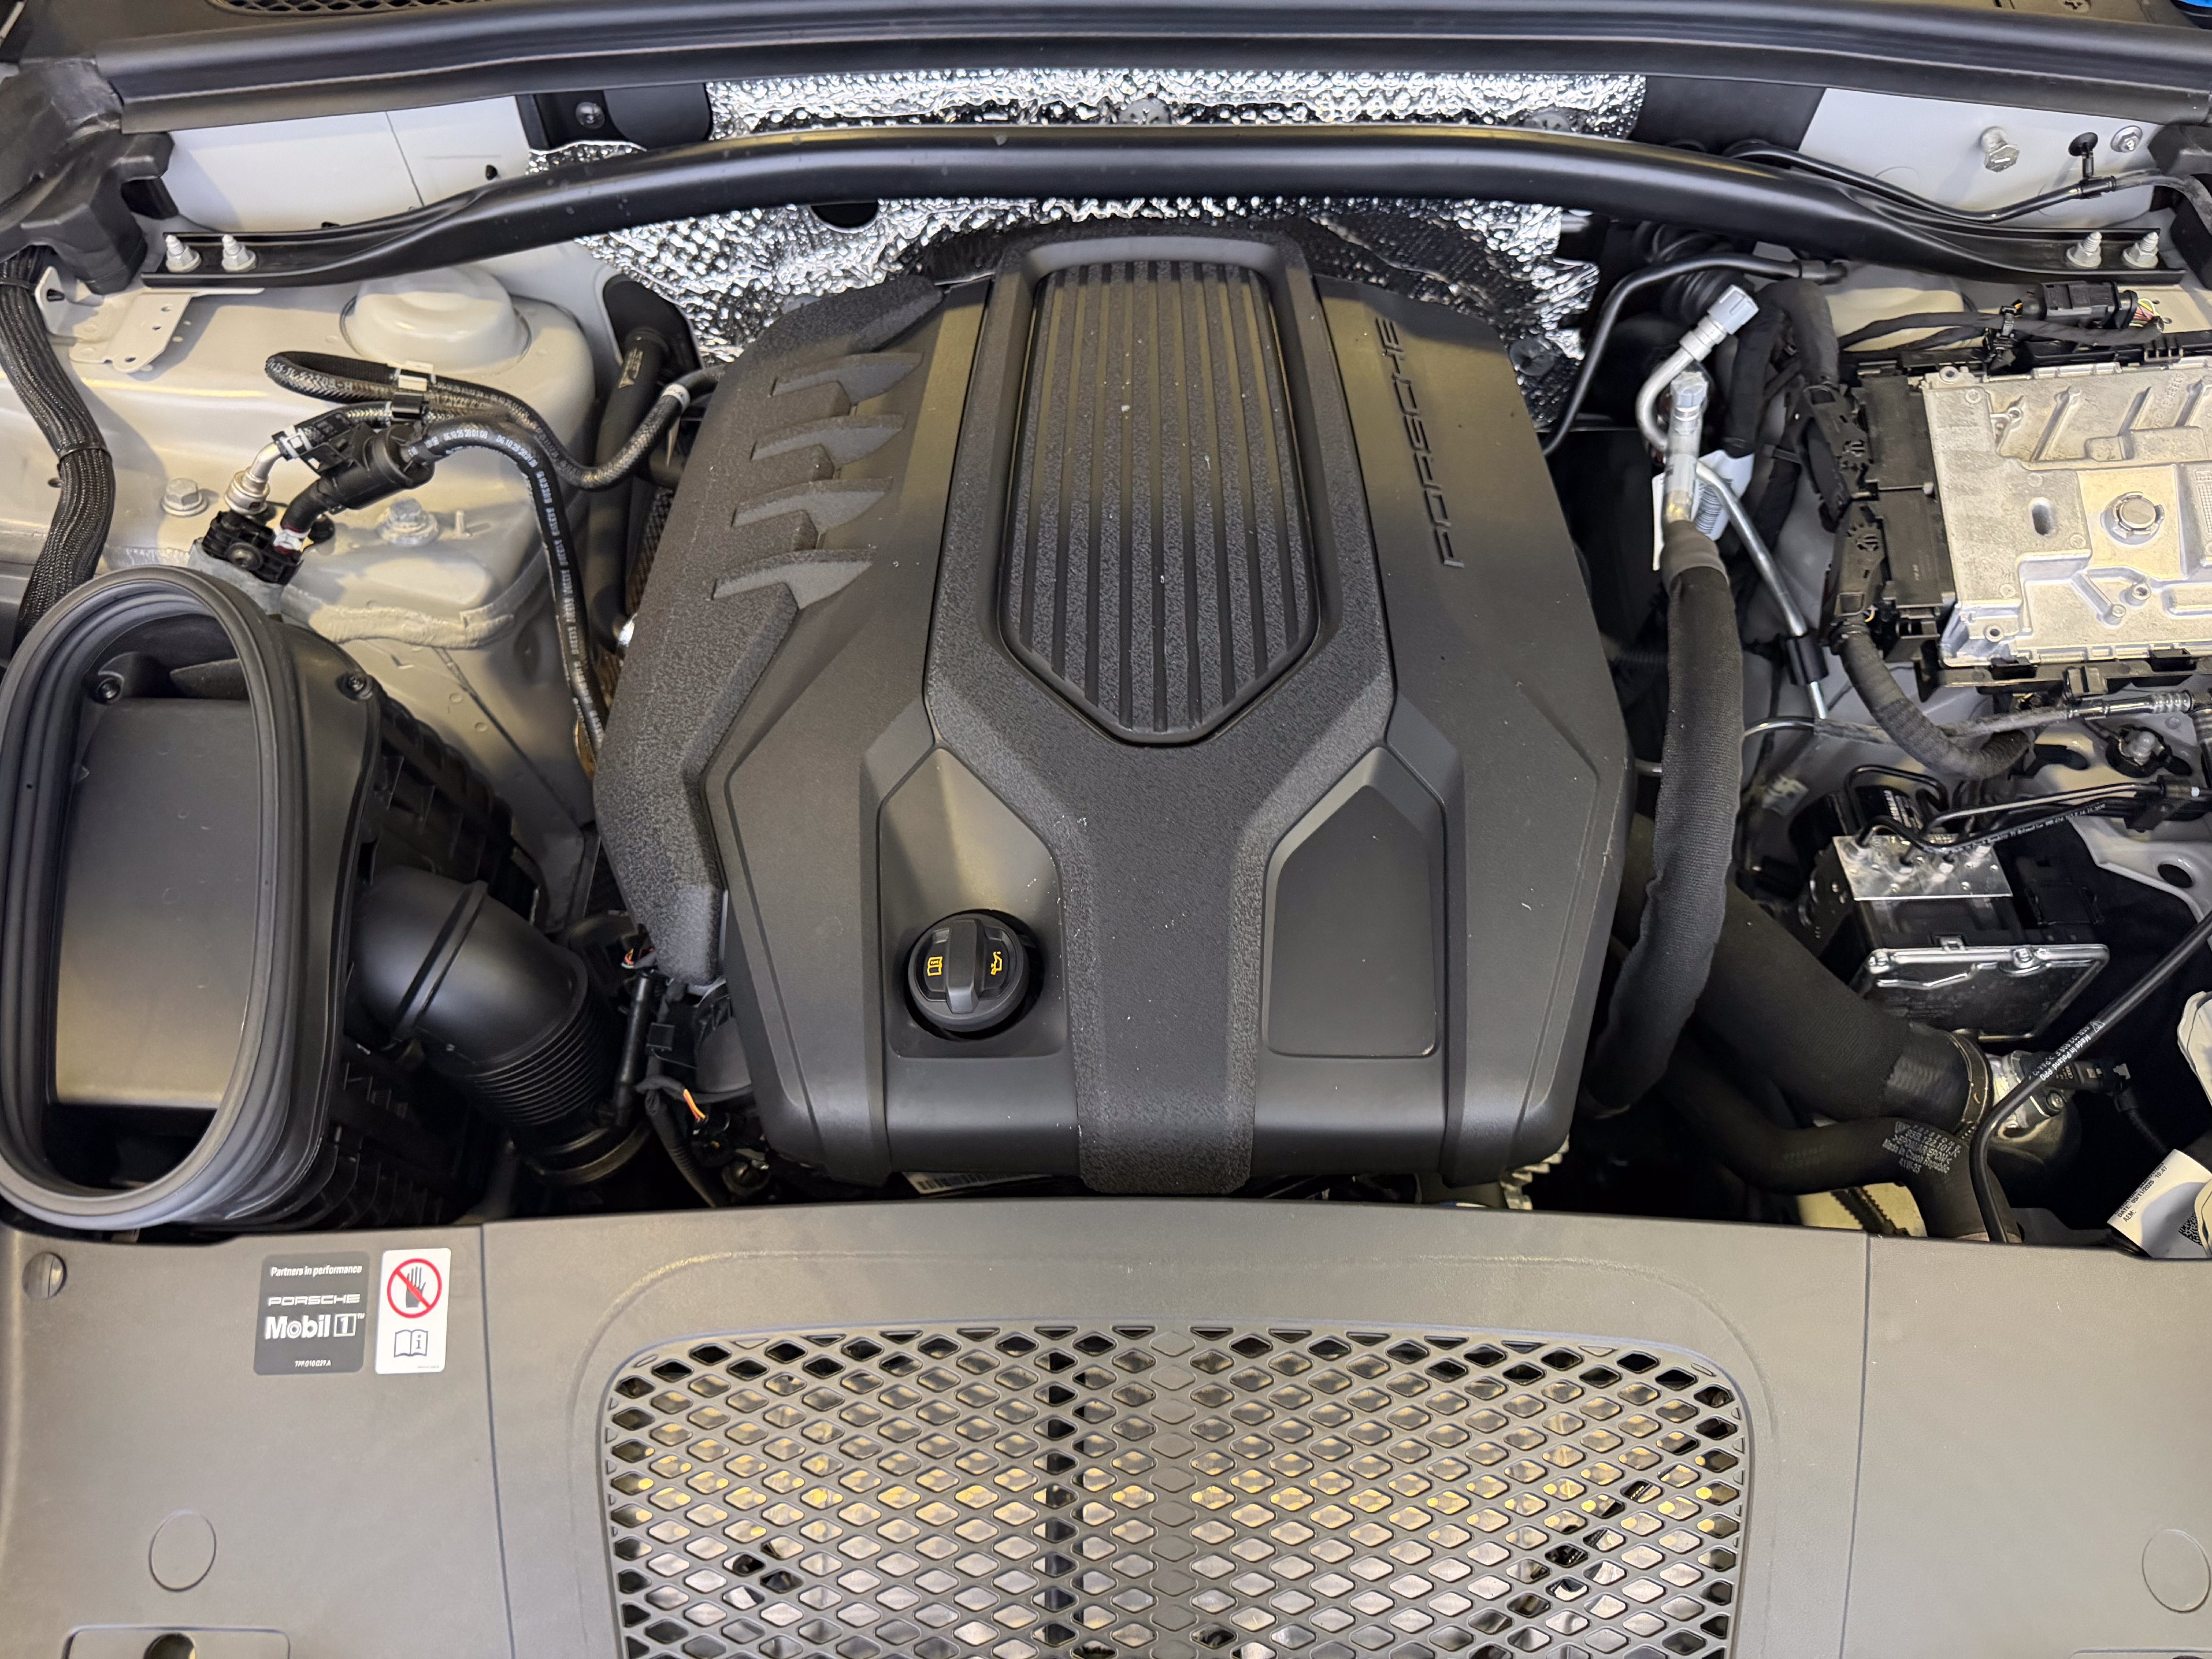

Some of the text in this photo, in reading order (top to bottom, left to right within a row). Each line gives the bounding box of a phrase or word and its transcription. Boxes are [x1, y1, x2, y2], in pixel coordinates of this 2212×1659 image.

[1375, 318, 1464, 568] PORSCHE
[2074, 1034, 2092, 1048] Made
[2052, 1053, 2072, 1070] Poland
[2131, 1179, 2155, 1204] 05/11/2025
[2155, 1165, 2168, 1179] 10:47
[271, 1264, 363, 1278] Partners in performance
[268, 1293, 361, 1306] PORSCHE
[265, 1314, 331, 1340] Mobil
